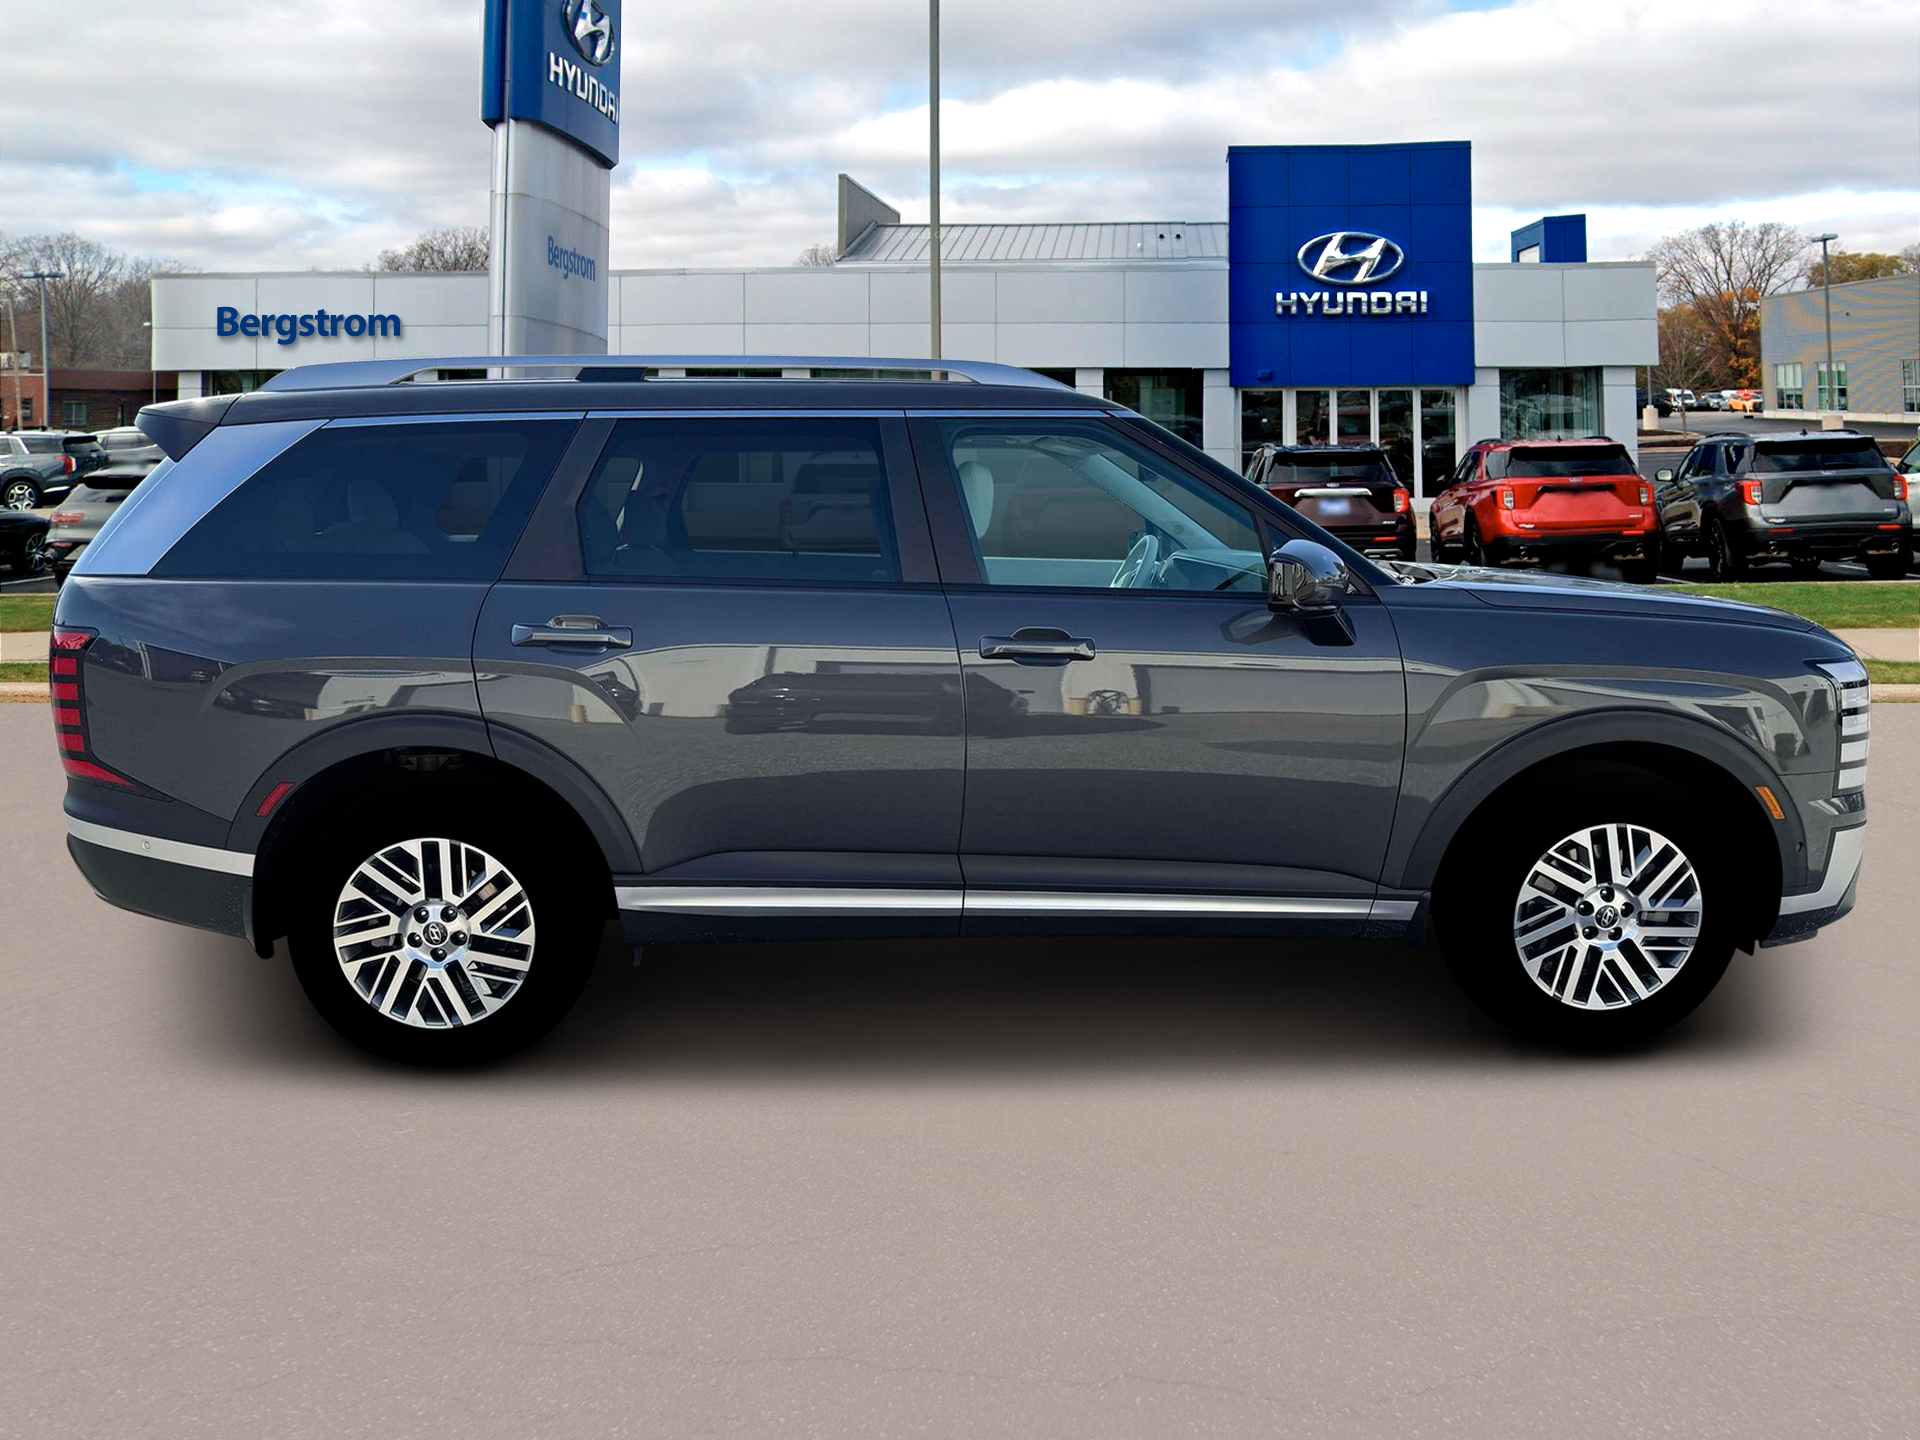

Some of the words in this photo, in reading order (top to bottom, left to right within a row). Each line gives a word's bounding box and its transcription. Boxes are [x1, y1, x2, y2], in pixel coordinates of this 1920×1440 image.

[549, 52, 619, 124] HYUNDAI
[548, 235, 596, 282] Bergstrom
[1276, 290, 1428, 315] HYUNDAI
[217, 306, 402, 346] Bergstrom
